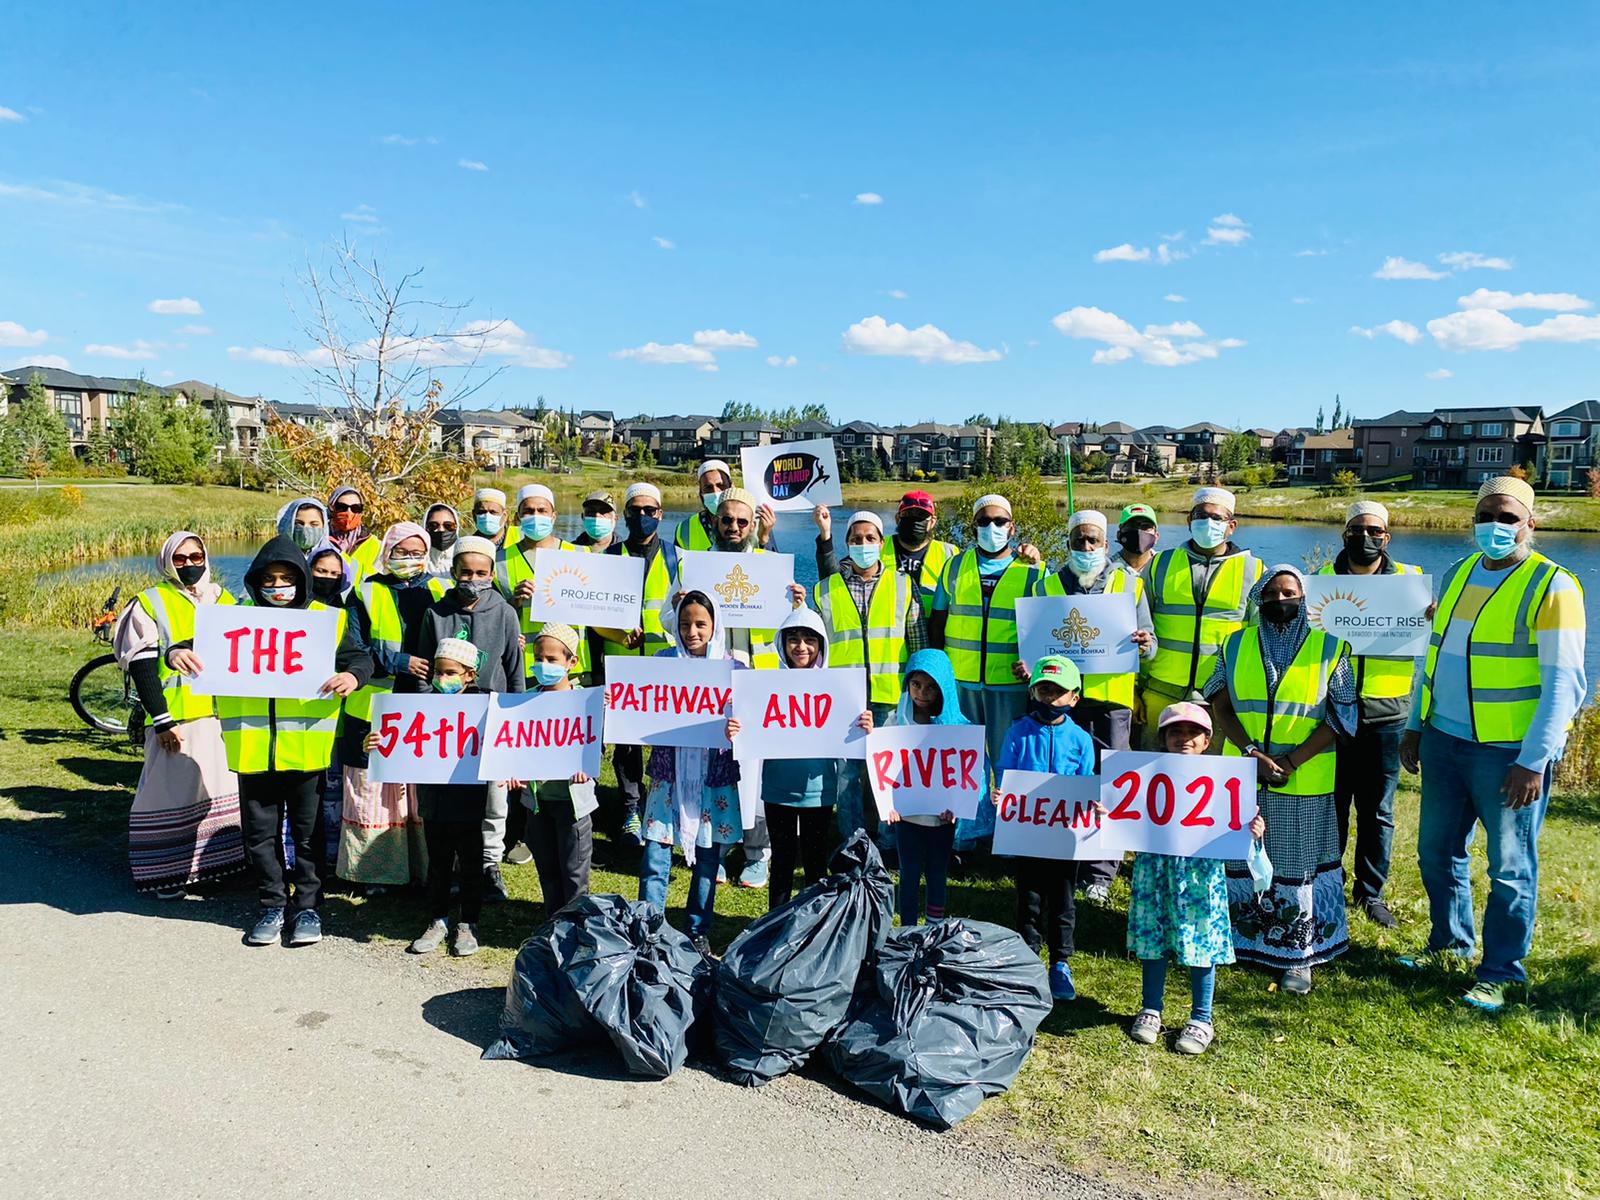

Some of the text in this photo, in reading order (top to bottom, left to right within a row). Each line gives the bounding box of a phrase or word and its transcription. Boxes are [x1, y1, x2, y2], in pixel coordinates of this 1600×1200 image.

[773, 457, 803, 472] WORLD
[773, 470, 810, 485] CLEANUP
[773, 485, 789, 497] DAY
[561, 589, 637, 604] PROJECT RISE
[1334, 616, 1425, 627] PROJECT RISE
[223, 626, 307, 675] THE
[610, 682, 732, 716] PATHWAY
[762, 693, 833, 729] AND
[377, 711, 480, 759] 54th
[493, 715, 597, 749] ANNUAL
[872, 747, 979, 791] RIVER
[1107, 770, 1243, 832] 2021
